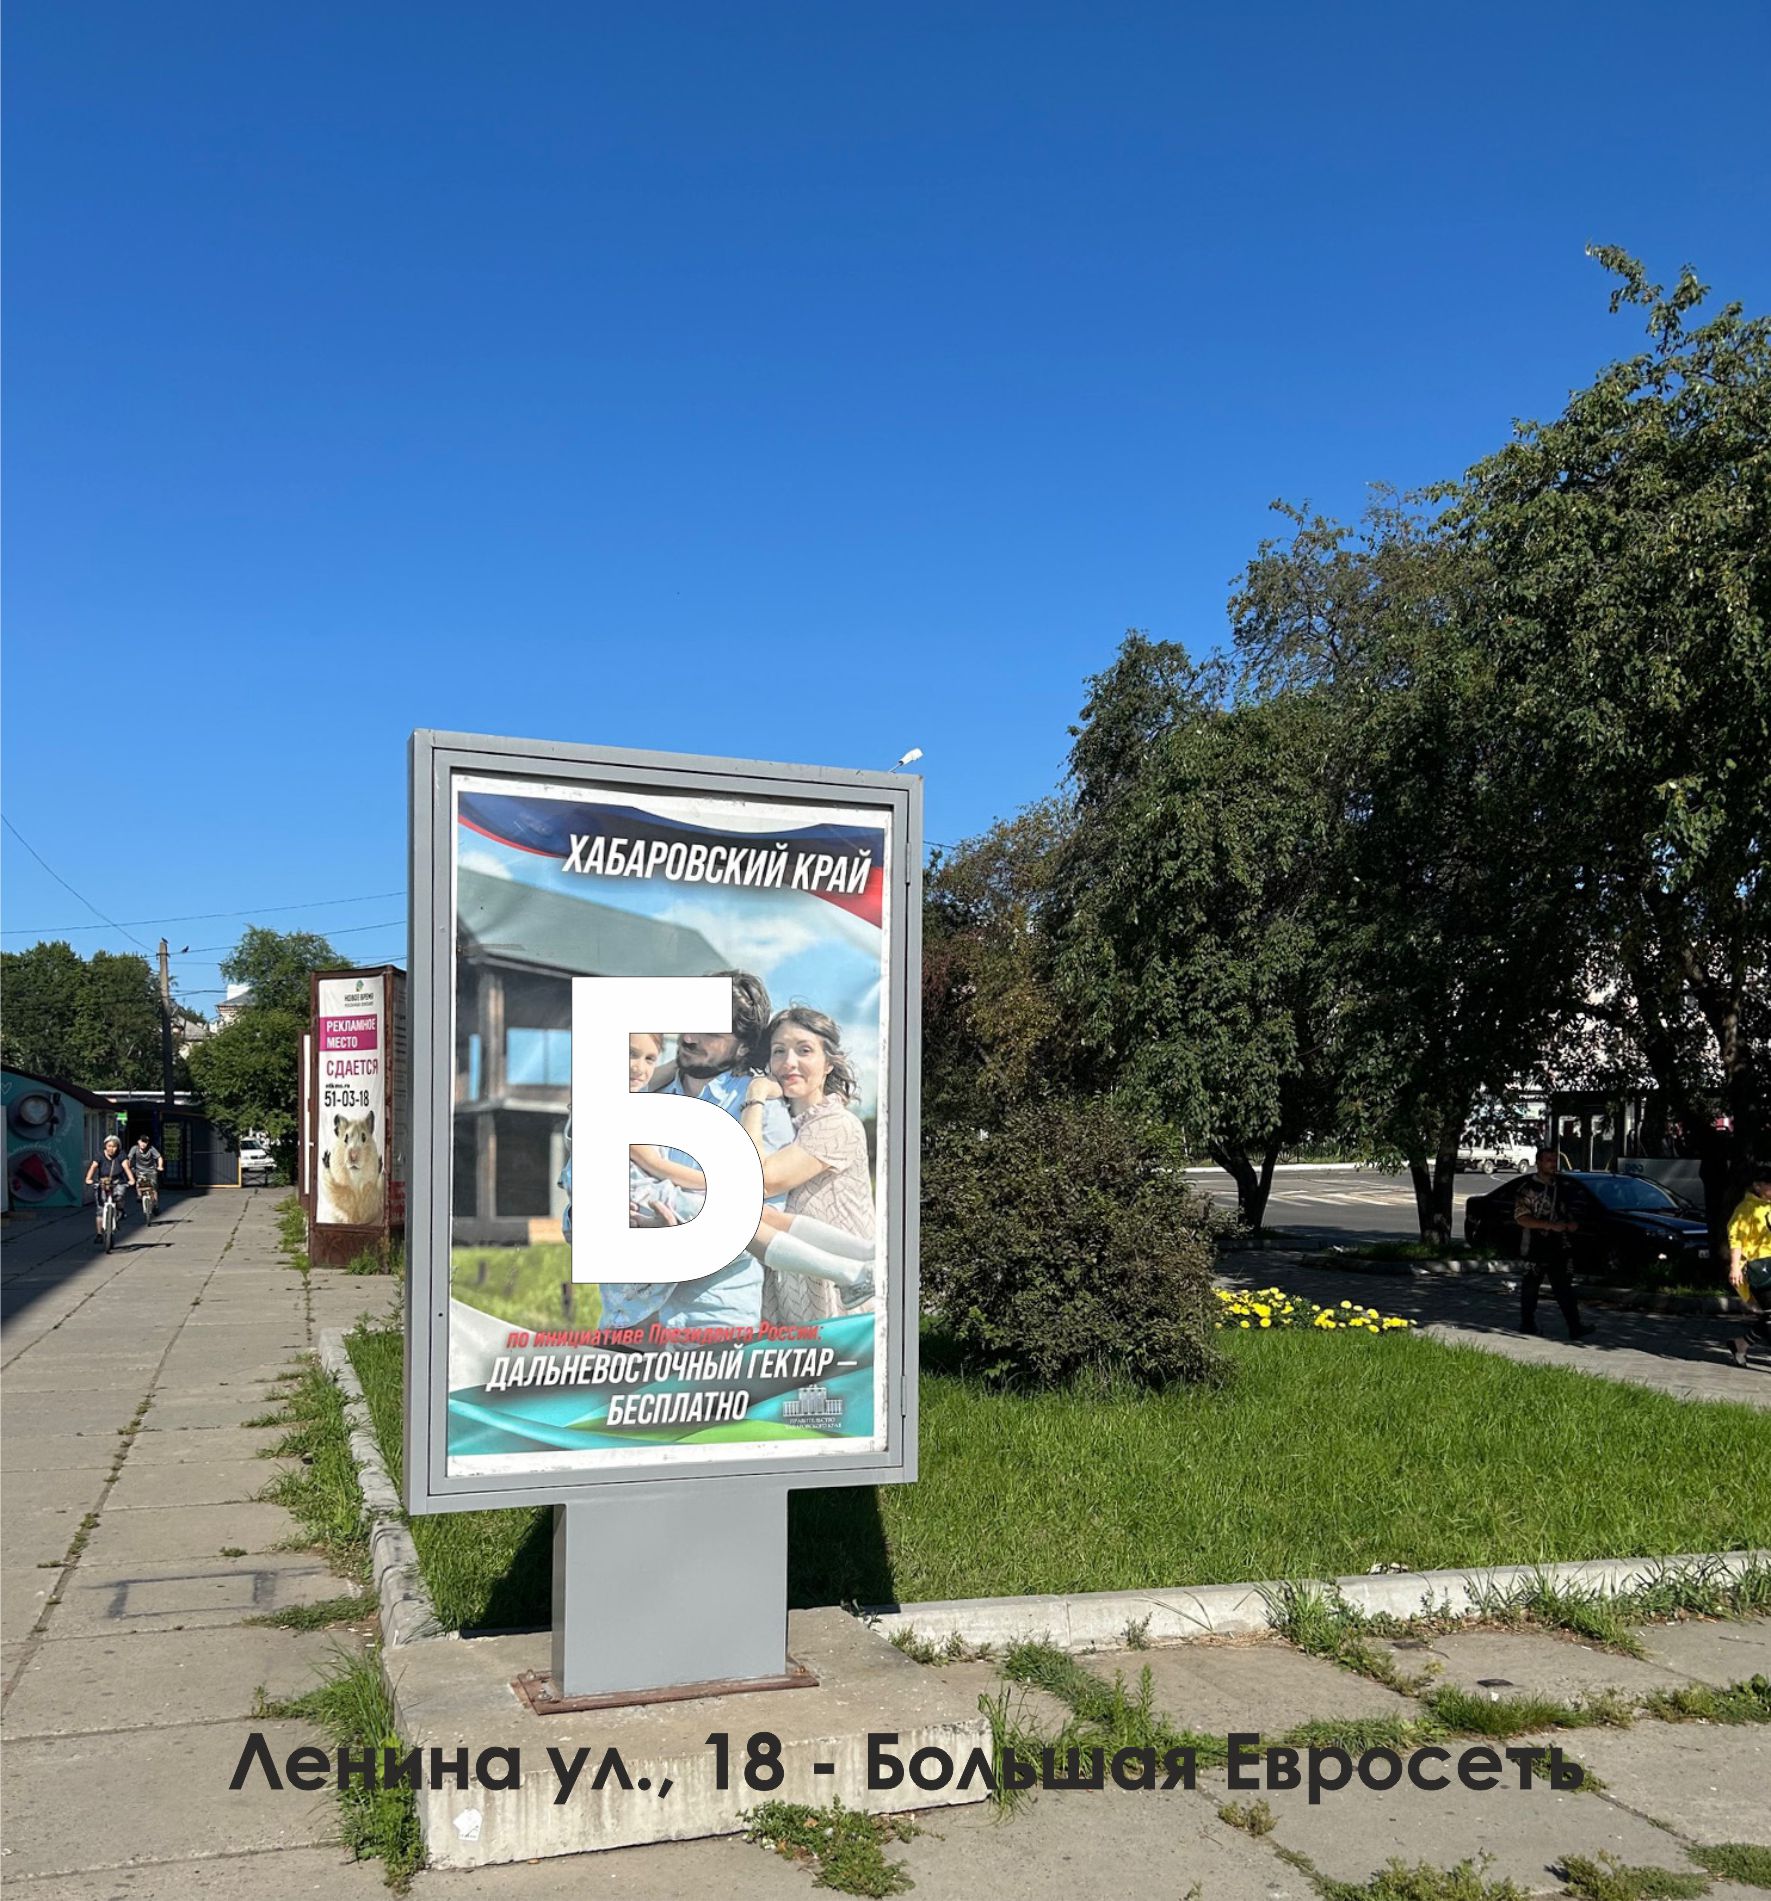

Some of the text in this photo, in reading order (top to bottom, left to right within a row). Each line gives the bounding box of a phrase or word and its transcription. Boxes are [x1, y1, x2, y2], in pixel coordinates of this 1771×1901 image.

[562, 833, 873, 895] ХАБАРОВСКИЙ КРАЙ
[326, 1018, 376, 1032] РЕКЛАМНОЕ
[326, 1036, 358, 1049] МЕСТО
[326, 1059, 378, 1078] СДАЕТСЯ
[324, 1090, 370, 1107] 51-03-18
[506, 1332, 531, 1350] по
[533, 1326, 644, 1349] инициативе
[648, 1322, 754, 1347] Президента
[486, 1344, 744, 1392] ДАЛЬНЕВОСТОЧНЫЙ
[747, 1347, 835, 1379] ГЕКТАР
[606, 1390, 750, 1426] БЕСПЛАТНО
